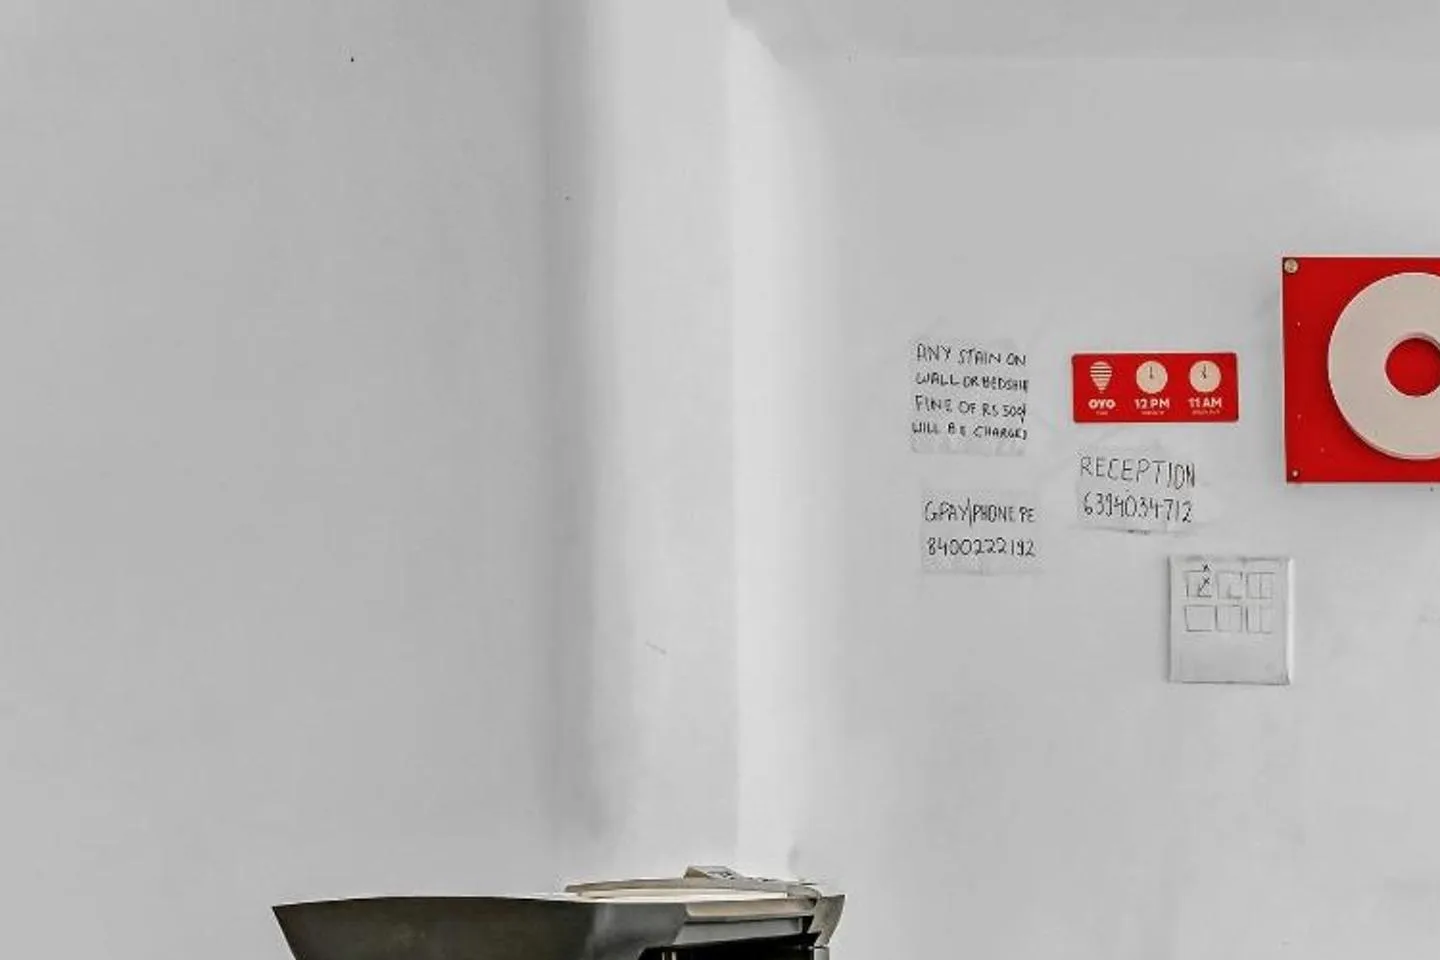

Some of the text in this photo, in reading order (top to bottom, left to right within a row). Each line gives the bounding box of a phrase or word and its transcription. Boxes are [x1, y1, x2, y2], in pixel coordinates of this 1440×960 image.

[917, 343, 1026, 366] ANY STAIN ON
[915, 371, 960, 387] WALL
[915, 395, 953, 412] FINE
[958, 400, 976, 414] OF
[1088, 399, 1116, 410] OYO
[1134, 398, 1170, 410] 12 PM
[1189, 397, 1222, 409] 11 AM
[1080, 456, 1195, 490] RECEPTION
